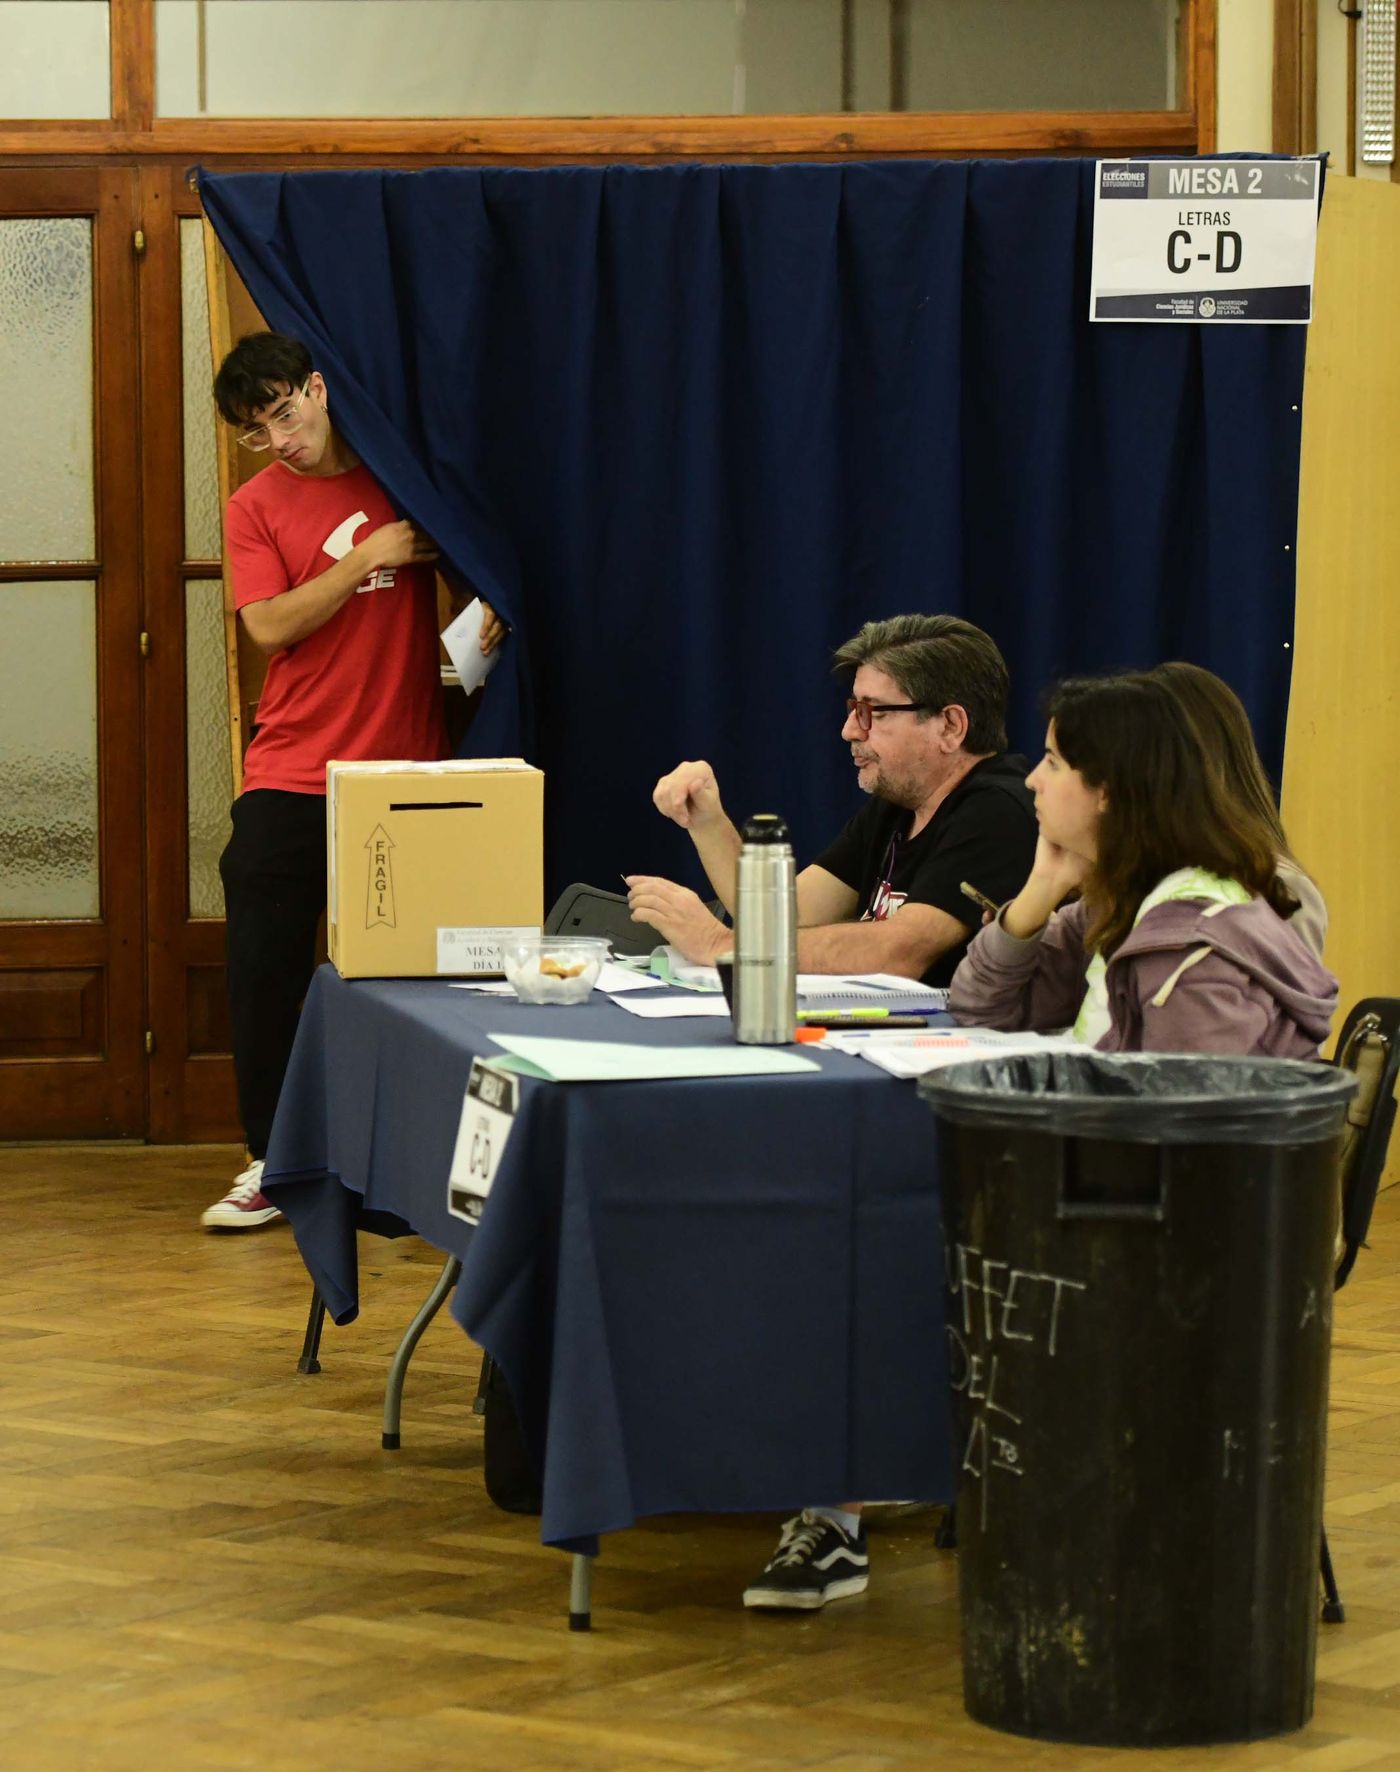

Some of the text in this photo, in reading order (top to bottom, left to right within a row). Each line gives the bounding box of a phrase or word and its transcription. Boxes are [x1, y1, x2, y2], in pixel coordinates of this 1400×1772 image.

[1103, 172, 1146, 181] ELECCIONES
[1168, 168, 1263, 194] MESA 2
[1178, 211, 1231, 226] LETRAS
[1167, 229, 1243, 274] C-D
[375, 841, 387, 917] FRAGIL
[473, 959, 494, 970] DÍA
